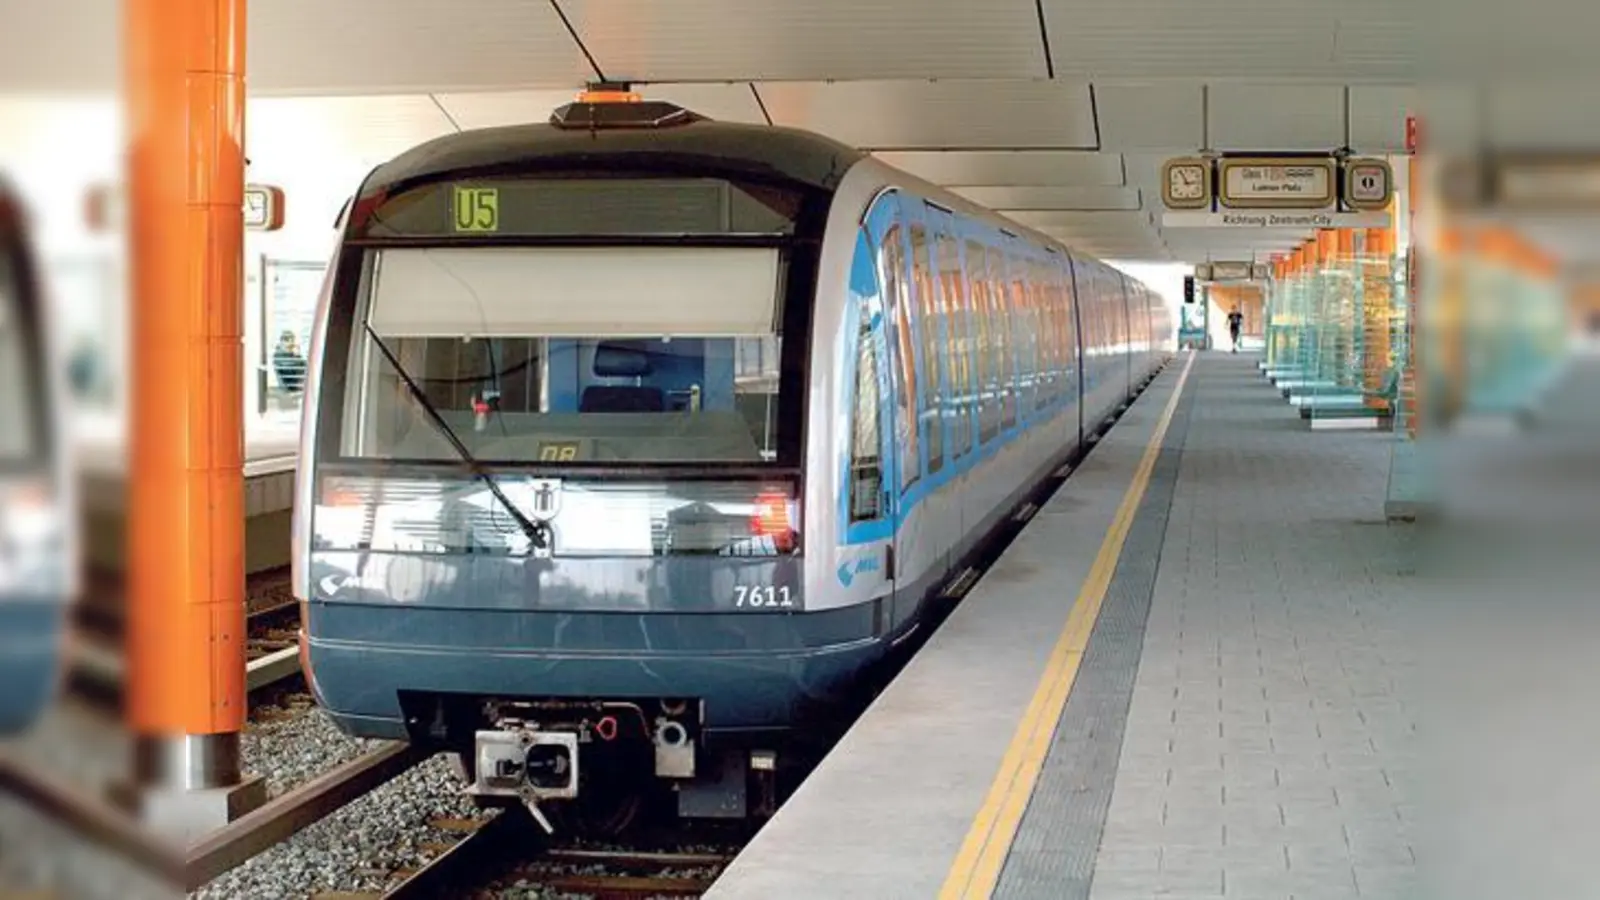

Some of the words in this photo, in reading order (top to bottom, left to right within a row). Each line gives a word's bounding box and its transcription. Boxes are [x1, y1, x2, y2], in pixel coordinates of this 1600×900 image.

[457, 190, 495, 229] U5
[1224, 214, 1267, 227] Richtung
[734, 585, 793, 607] 7611
